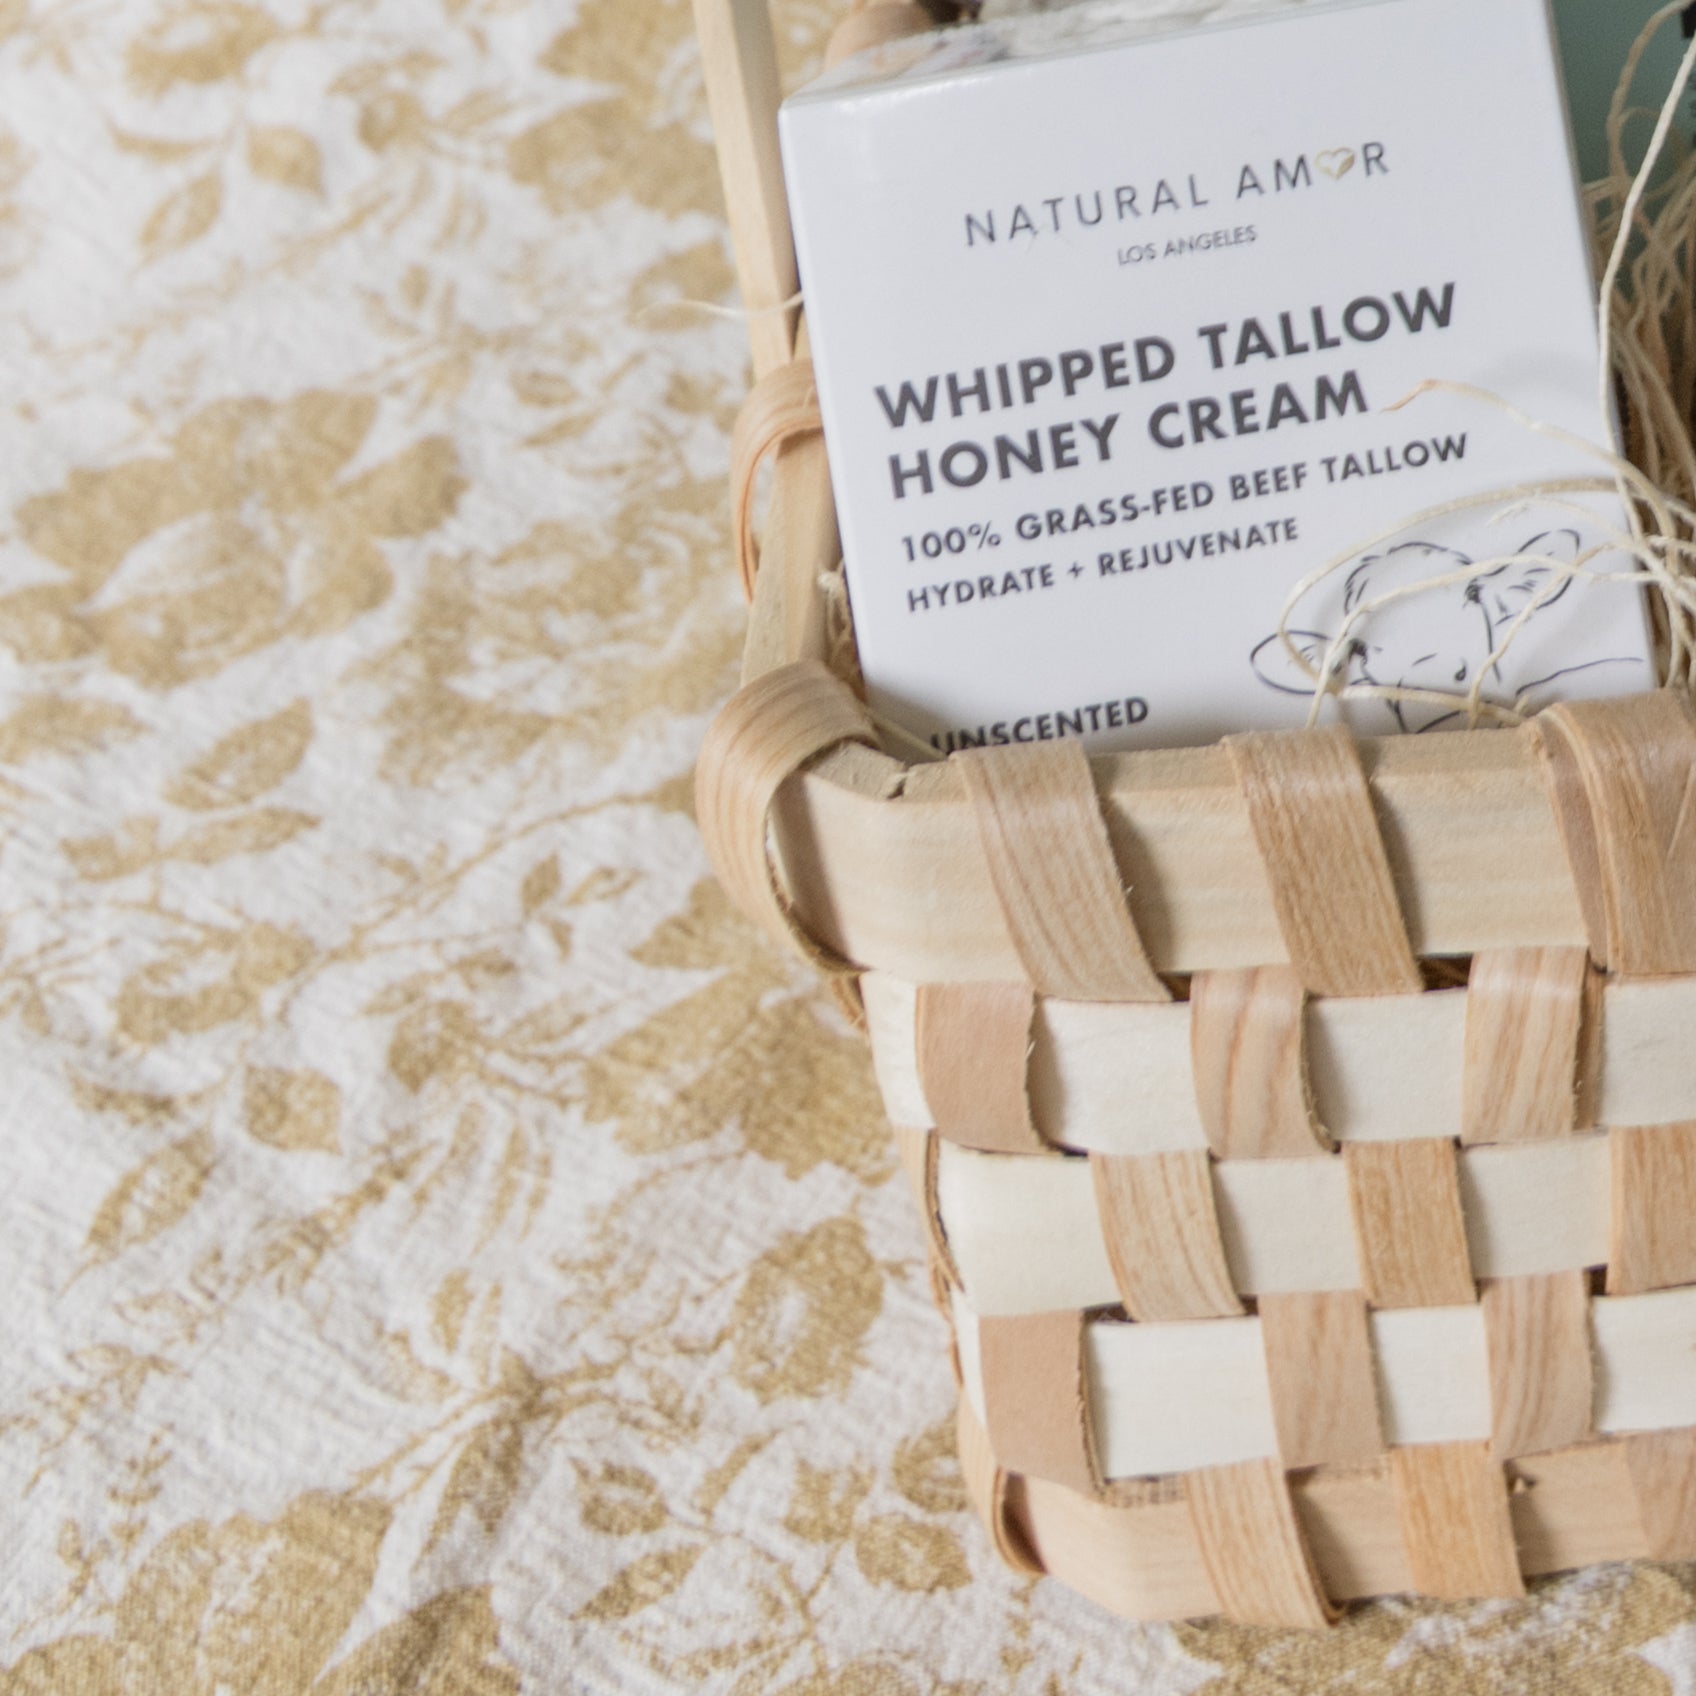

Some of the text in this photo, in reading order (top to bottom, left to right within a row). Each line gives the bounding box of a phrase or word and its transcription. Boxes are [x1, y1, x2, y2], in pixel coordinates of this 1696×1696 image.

[964, 170, 1209, 248] NATURAL
[1117, 223, 1258, 267] LOS ANGELES
[875, 281, 1457, 428] WHIPPED TALLOW
[888, 369, 1368, 500] HONEY CREAM
[901, 432, 1470, 566] 100% GRASS-FED BEEF TALLOW
[906, 516, 1301, 614] HYDRATE + REJUVENATE
[930, 695, 1149, 756] UNSCENTED
